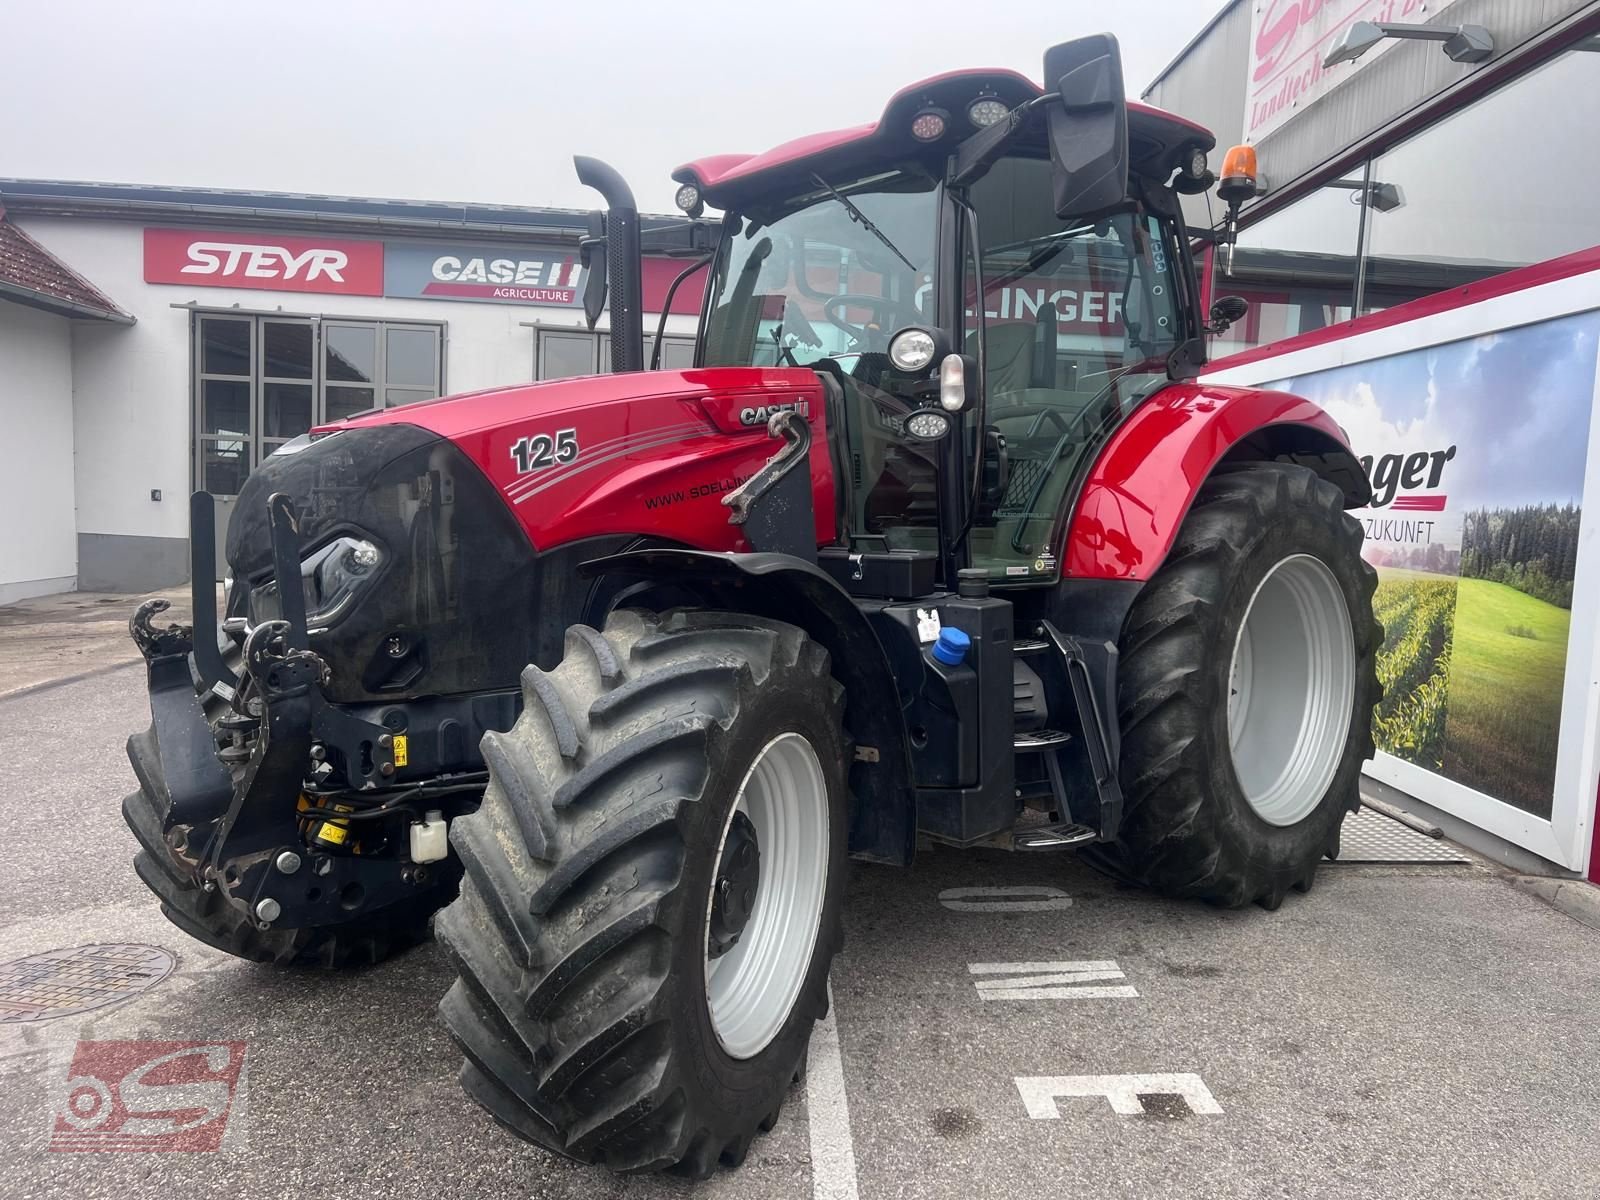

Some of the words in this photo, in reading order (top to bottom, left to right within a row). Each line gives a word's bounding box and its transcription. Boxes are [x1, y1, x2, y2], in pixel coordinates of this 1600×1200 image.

[1250, 52, 1339, 131] Landtech
[180, 241, 348, 283] STEYR
[431, 256, 544, 285] CASE
[493, 287, 569, 302] AGRICULTURE
[510, 427, 579, 474] 125
[1365, 518, 1435, 544] ZUKUNFT
